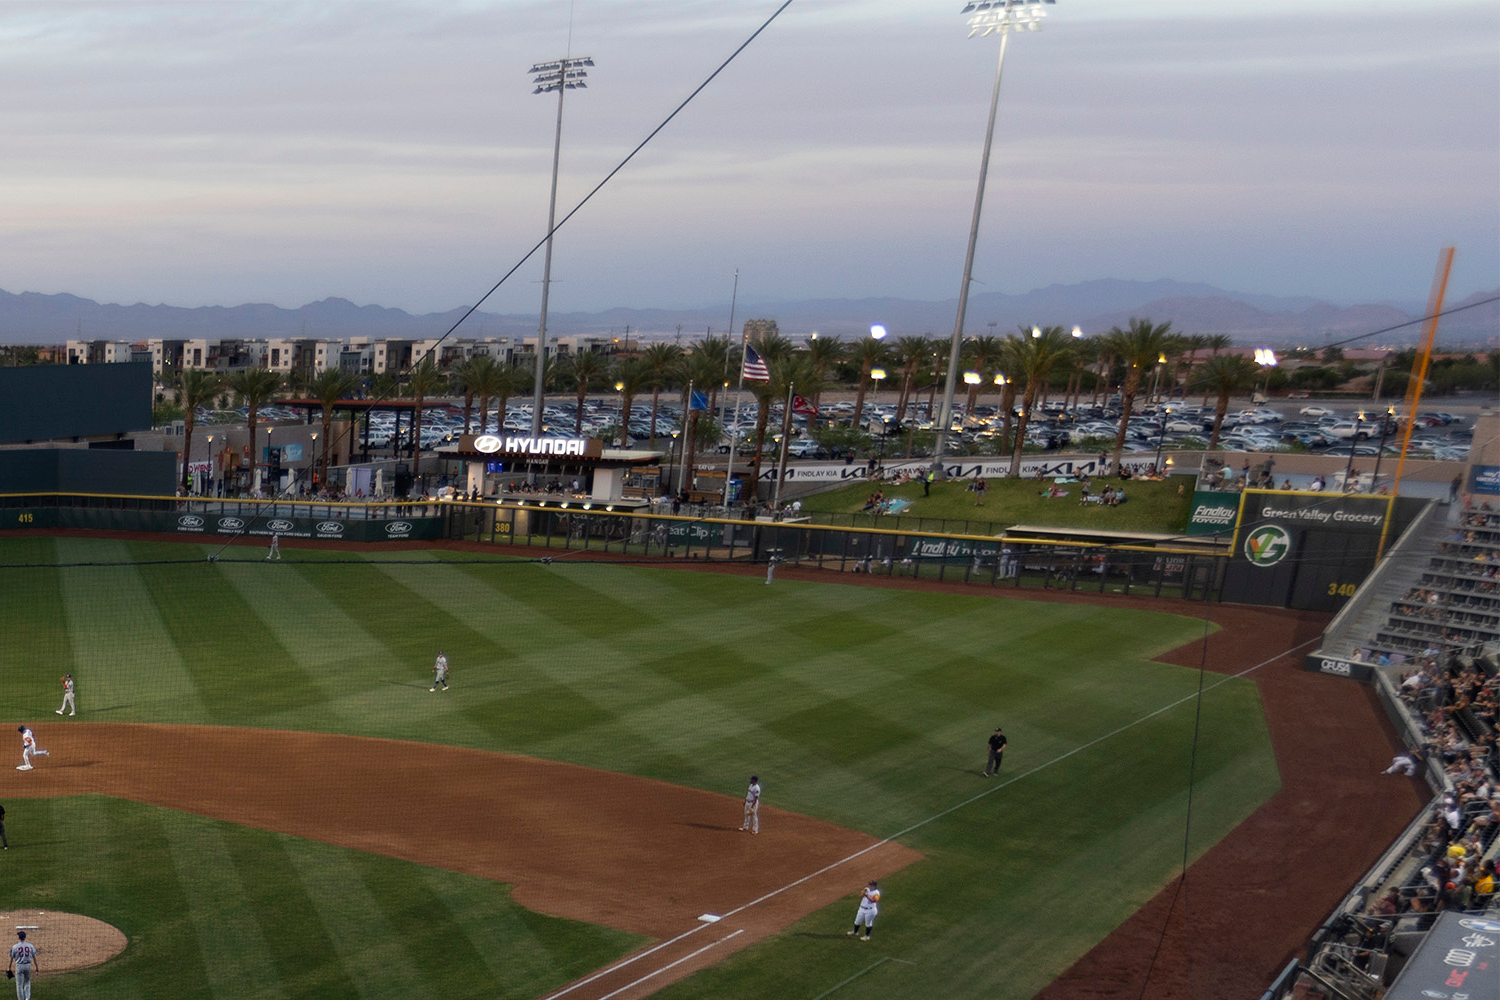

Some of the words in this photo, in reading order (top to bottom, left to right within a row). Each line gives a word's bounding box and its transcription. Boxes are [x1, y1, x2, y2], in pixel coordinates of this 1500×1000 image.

[505, 437, 585, 456] HYUNDAI
[797, 470, 825, 478] FINDLAY
[1194, 504, 1236, 520] Findlay
[1262, 507, 1300, 519] Green
[1299, 509, 1332, 523] Valley
[1333, 510, 1382, 526] Grocery
[18, 513, 33, 523] 415
[180, 516, 203, 527] Ford
[220, 518, 243, 528] Ford
[1191, 517, 1229, 525] TOYOTA
[268, 520, 292, 531] Ford
[318, 522, 342, 533] Ford
[387, 522, 411, 533] Ford
[494, 522, 510, 533] 380
[1327, 582, 1356, 596] 340
[18, 946, 30, 958] 29
